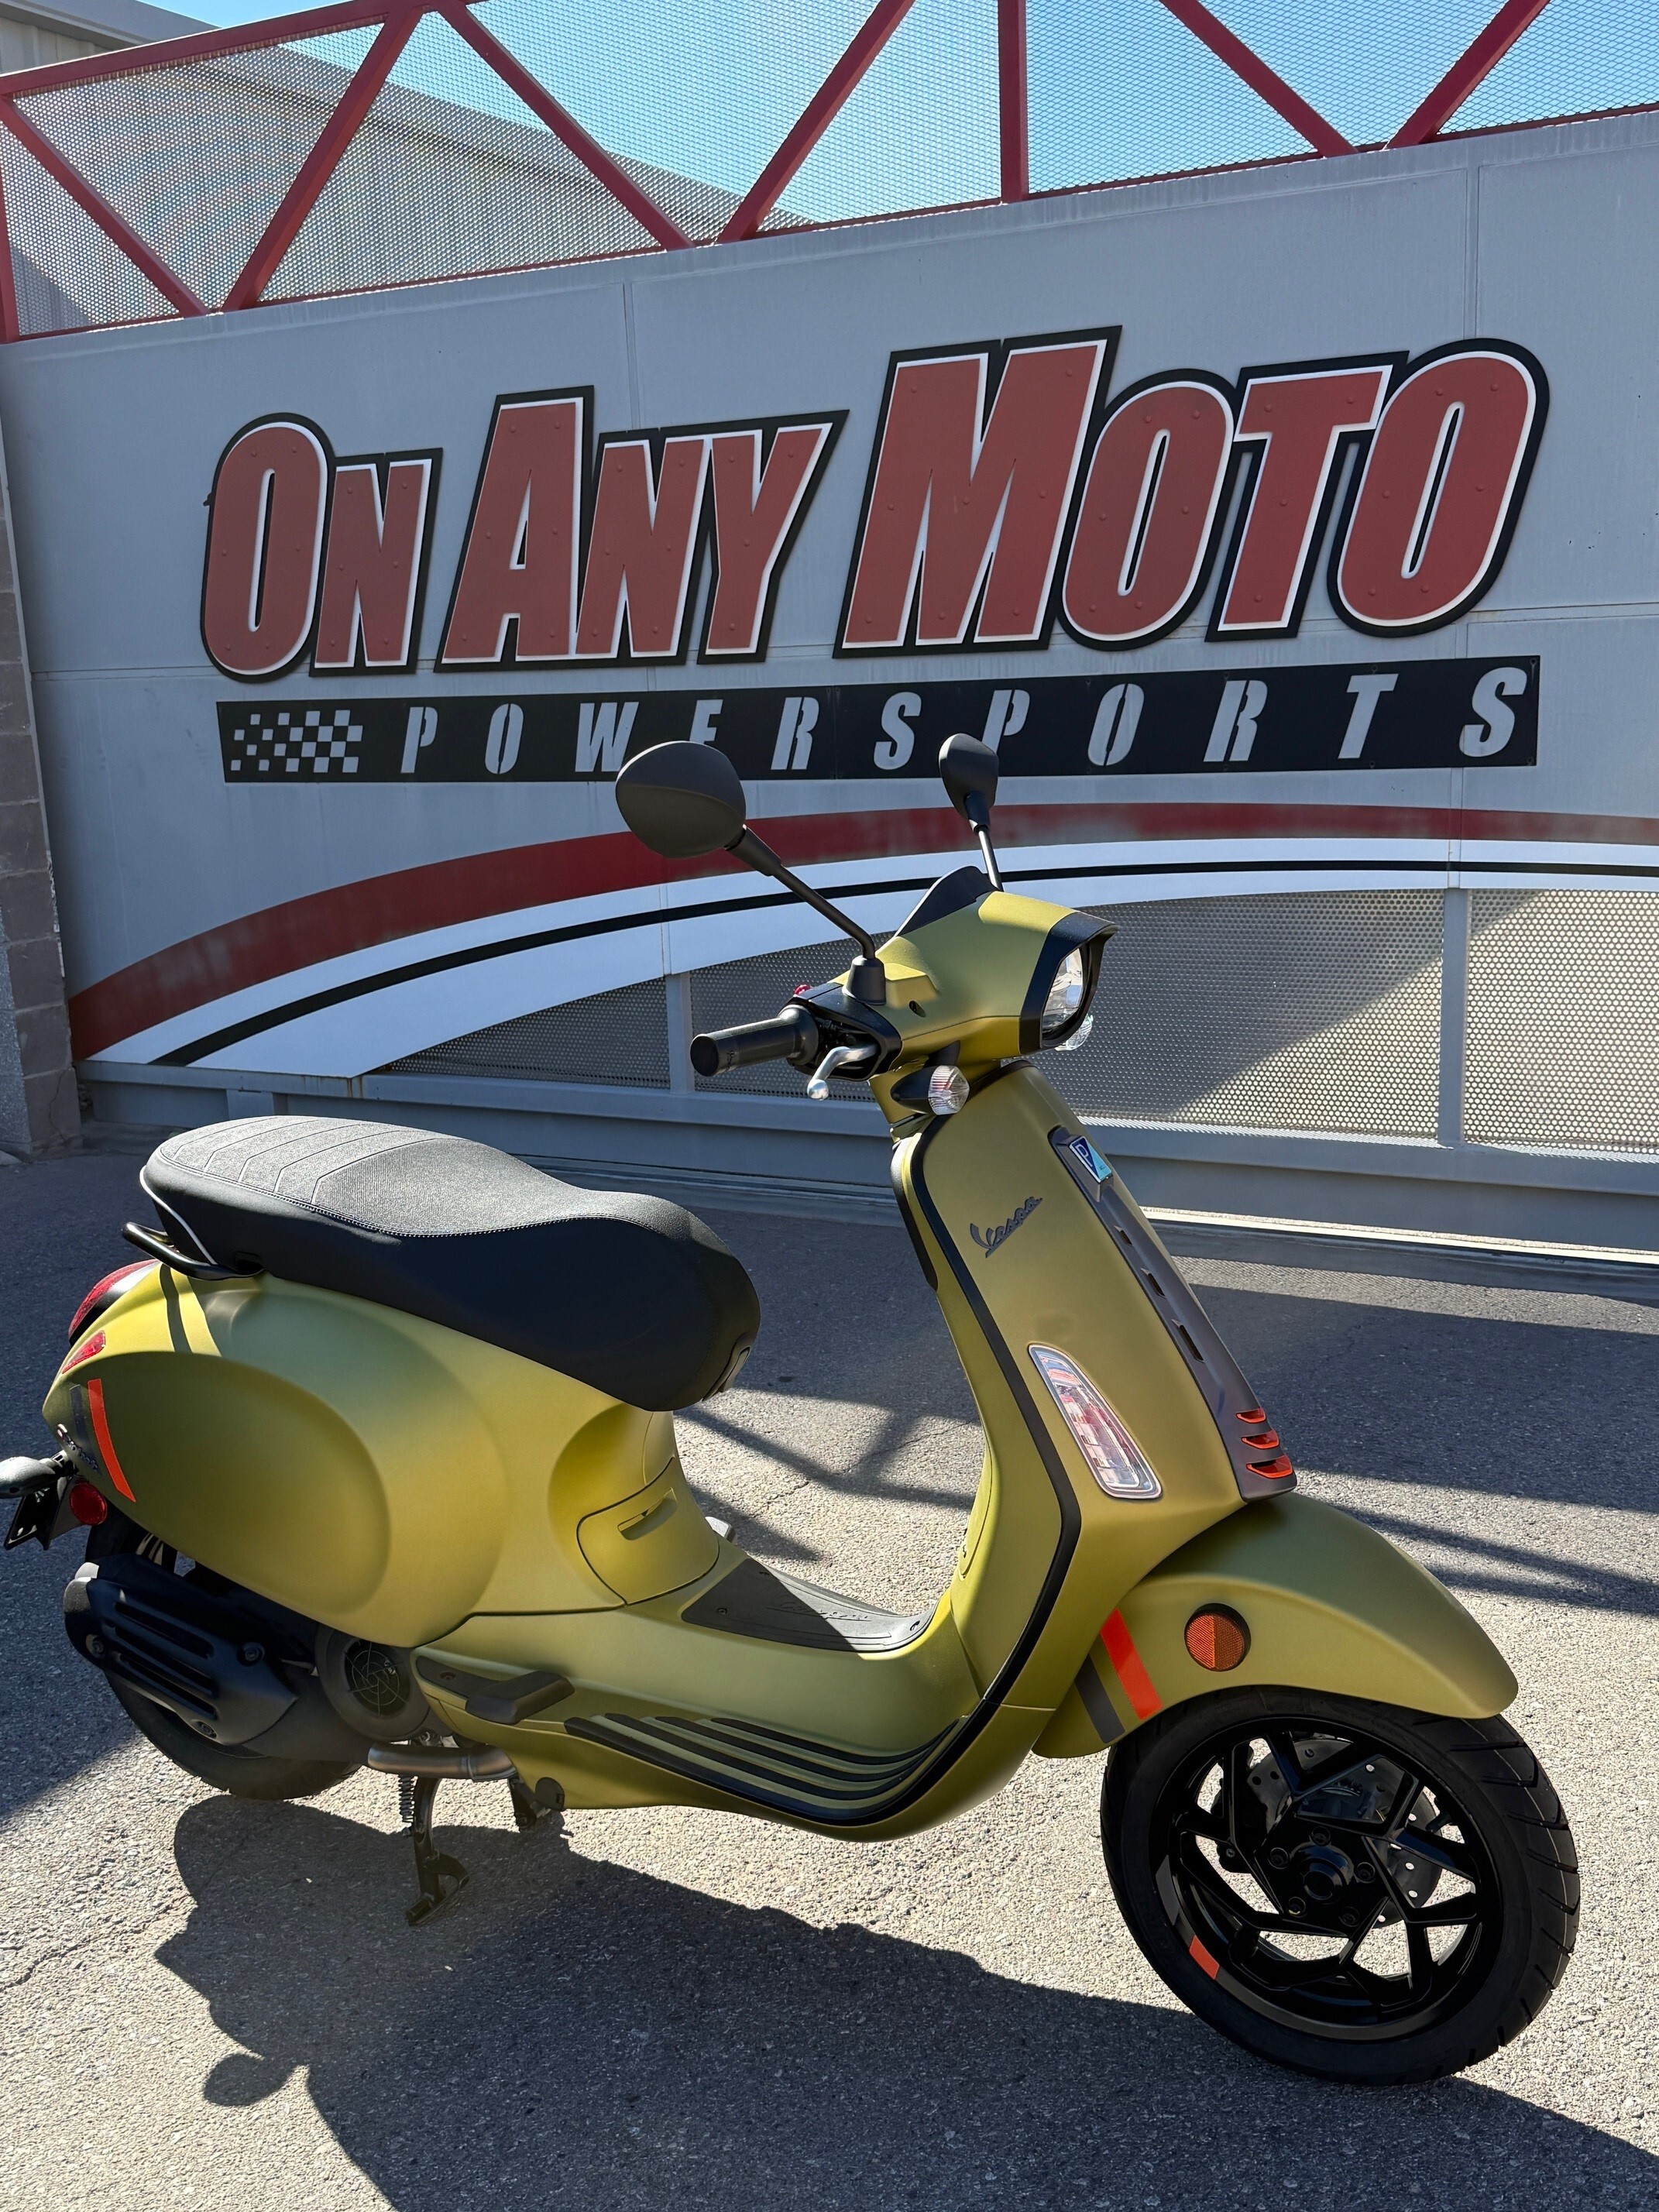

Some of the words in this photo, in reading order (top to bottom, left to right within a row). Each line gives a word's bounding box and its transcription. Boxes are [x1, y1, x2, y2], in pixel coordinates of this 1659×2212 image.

[201, 418, 435, 678] ON
[441, 395, 836, 664] ANY
[840, 337, 1539, 650] MOTO
[400, 666, 1527, 775] POWERSPORTS
[970, 1196, 1043, 1259] Vespa
